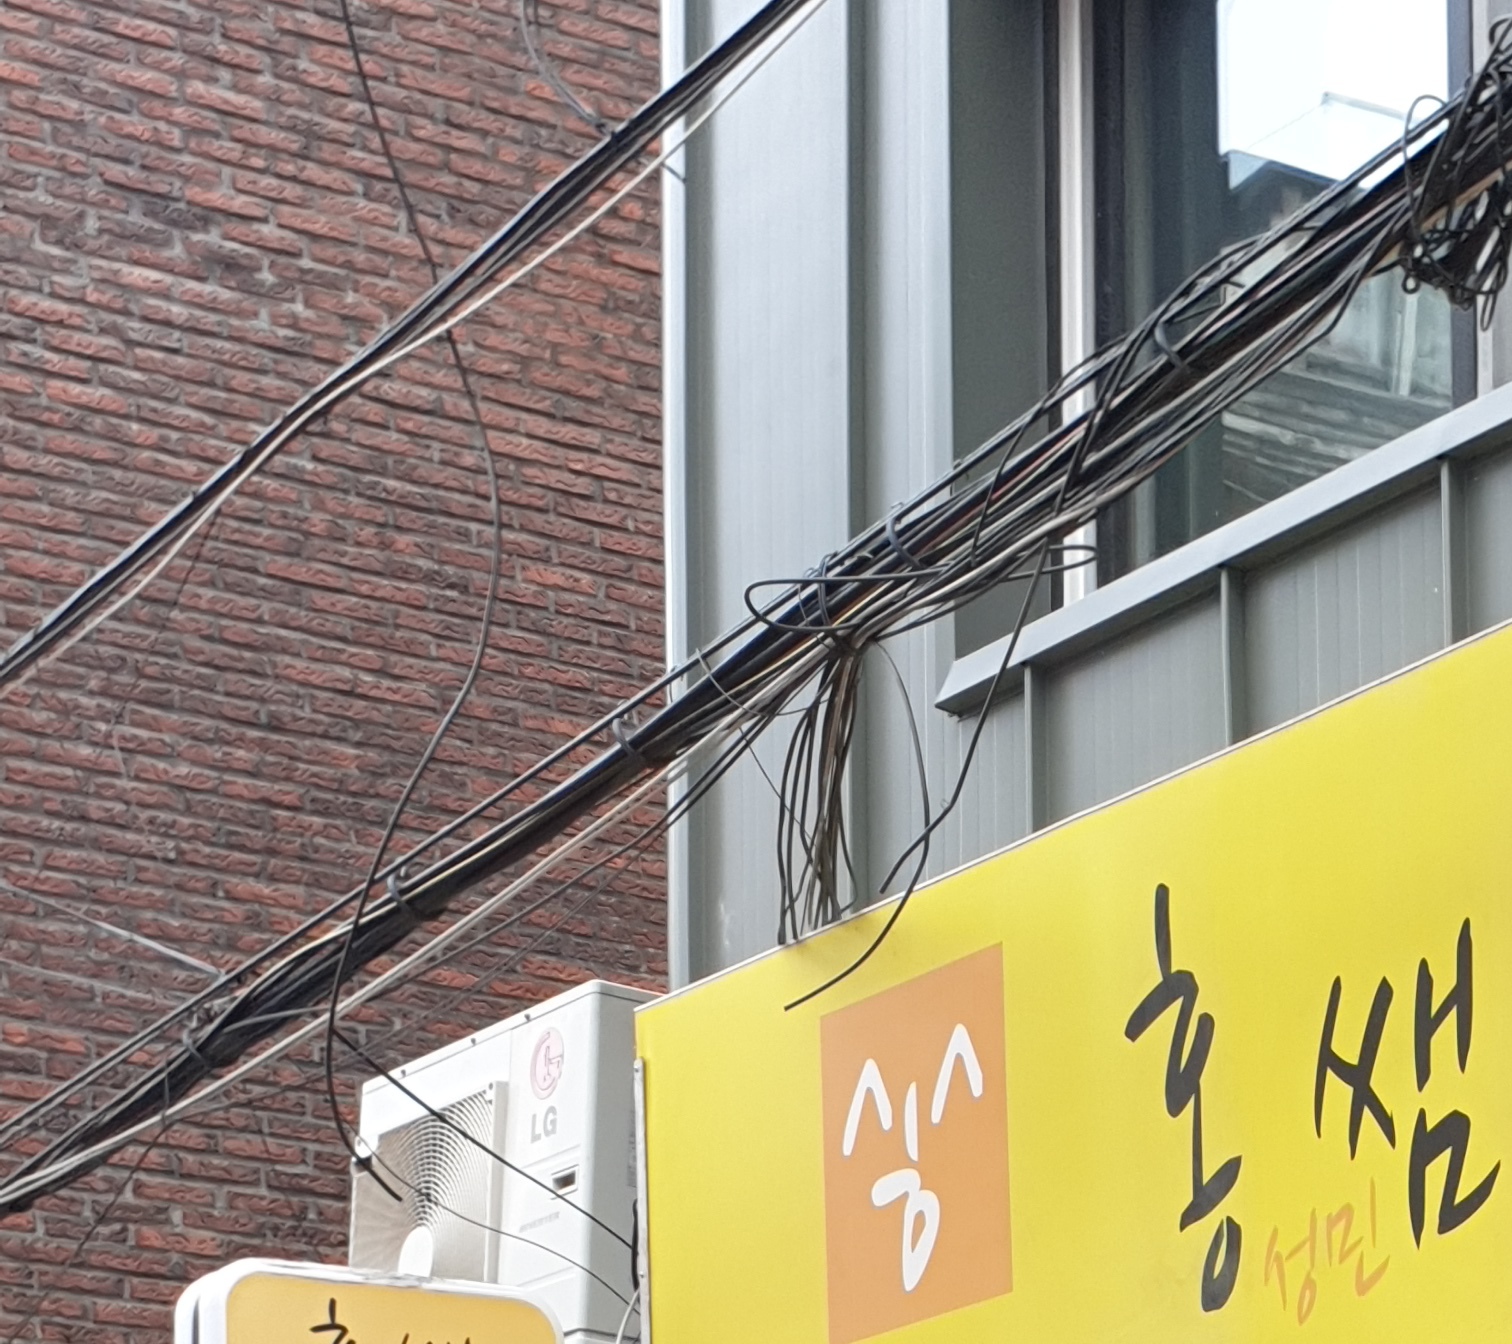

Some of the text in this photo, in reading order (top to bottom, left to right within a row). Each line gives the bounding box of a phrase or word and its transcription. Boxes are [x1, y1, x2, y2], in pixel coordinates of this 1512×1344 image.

[530, 1105, 558, 1145] LG
[1124, 883, 1243, 1313] 홍
[1314, 917, 1502, 1250] 쌤
[1264, 1176, 1391, 1327] 성민
